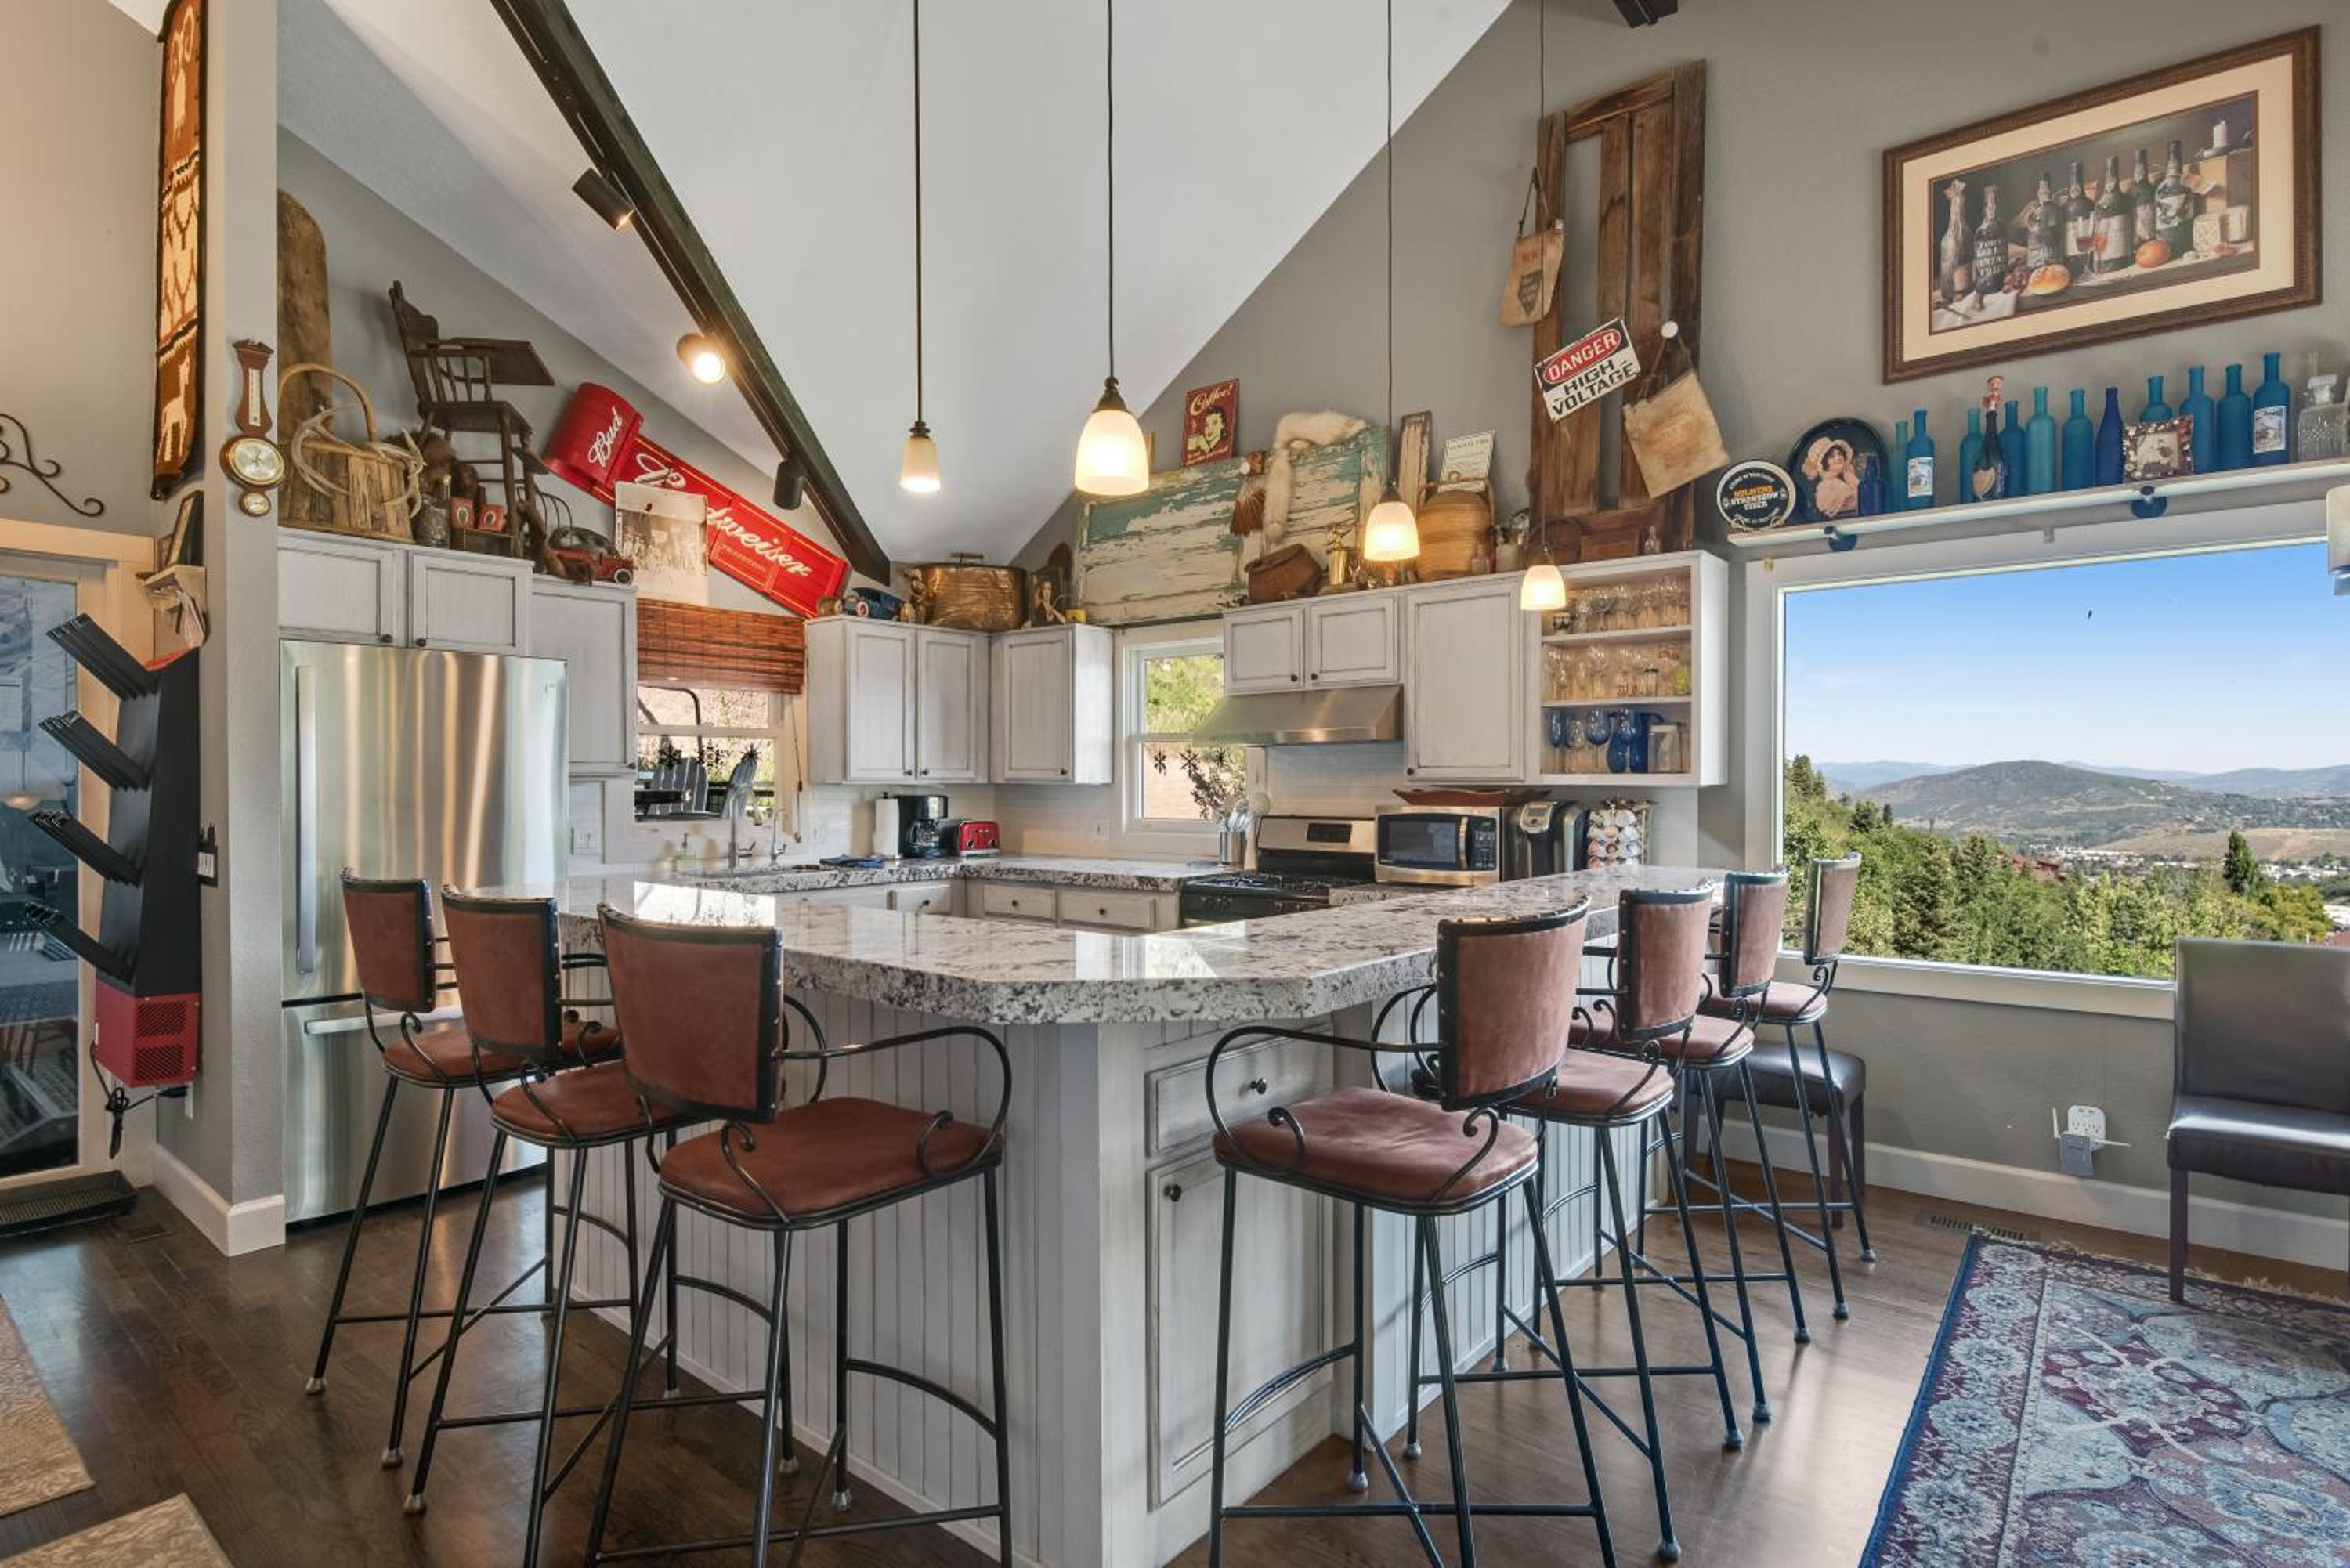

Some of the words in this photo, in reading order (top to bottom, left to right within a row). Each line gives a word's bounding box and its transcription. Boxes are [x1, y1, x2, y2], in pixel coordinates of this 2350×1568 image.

[1548, 332, 1618, 381] DANGER
[1563, 359, 1614, 396] HIGH
[1552, 362, 1633, 416] VOLTAGE
[588, 406, 623, 468] Bud
[634, 453, 812, 578] Bdweiser
